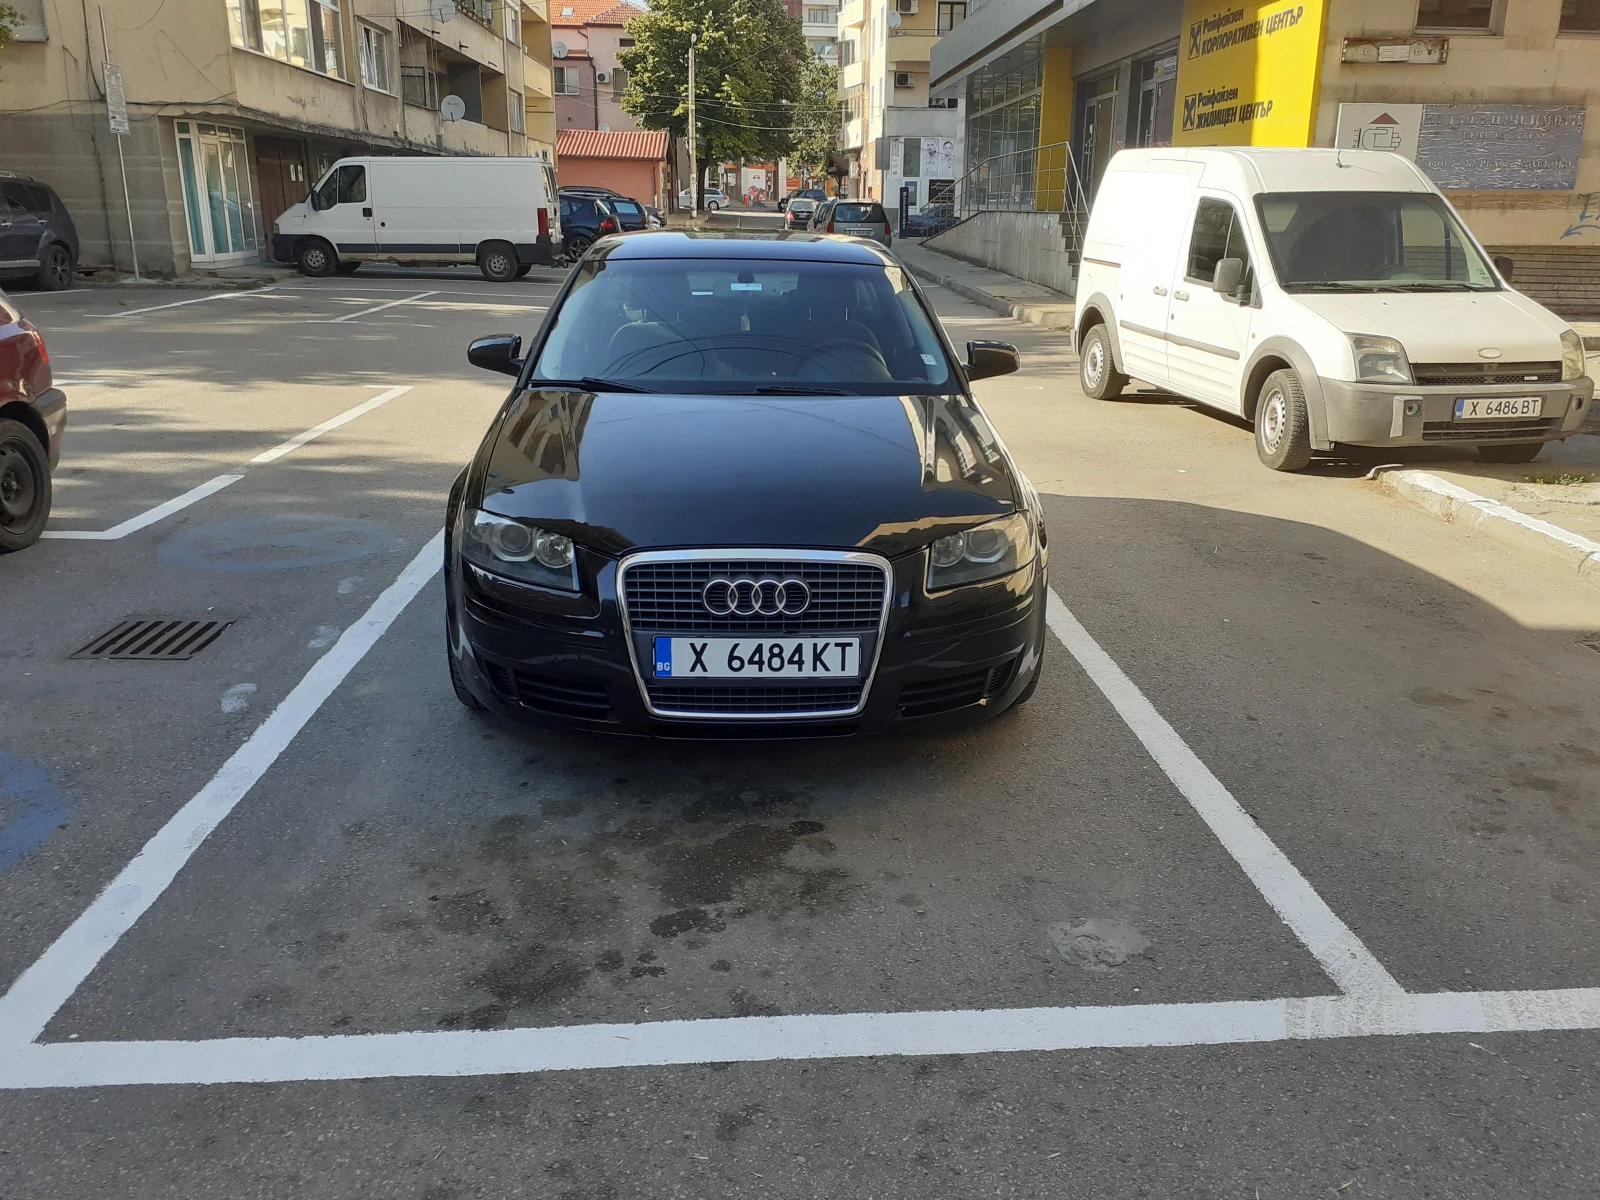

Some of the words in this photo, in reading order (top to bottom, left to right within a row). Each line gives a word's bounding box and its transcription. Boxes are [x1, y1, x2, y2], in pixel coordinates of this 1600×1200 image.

[1201, 19, 1264, 56] КОРПОРАТИВЕН
[1265, 6, 1304, 36] ЦЕНТЪР
[1203, 8, 1244, 34] Райфайзен
[1197, 86, 1239, 109] Райфайзен
[1195, 106, 1238, 129] ЖИЛИЩЕН
[1238, 100, 1273, 124] ЦЕНТЪР
[1469, 401, 1480, 416] X
[656, 661, 671, 672] BG
[689, 642, 708, 673] X
